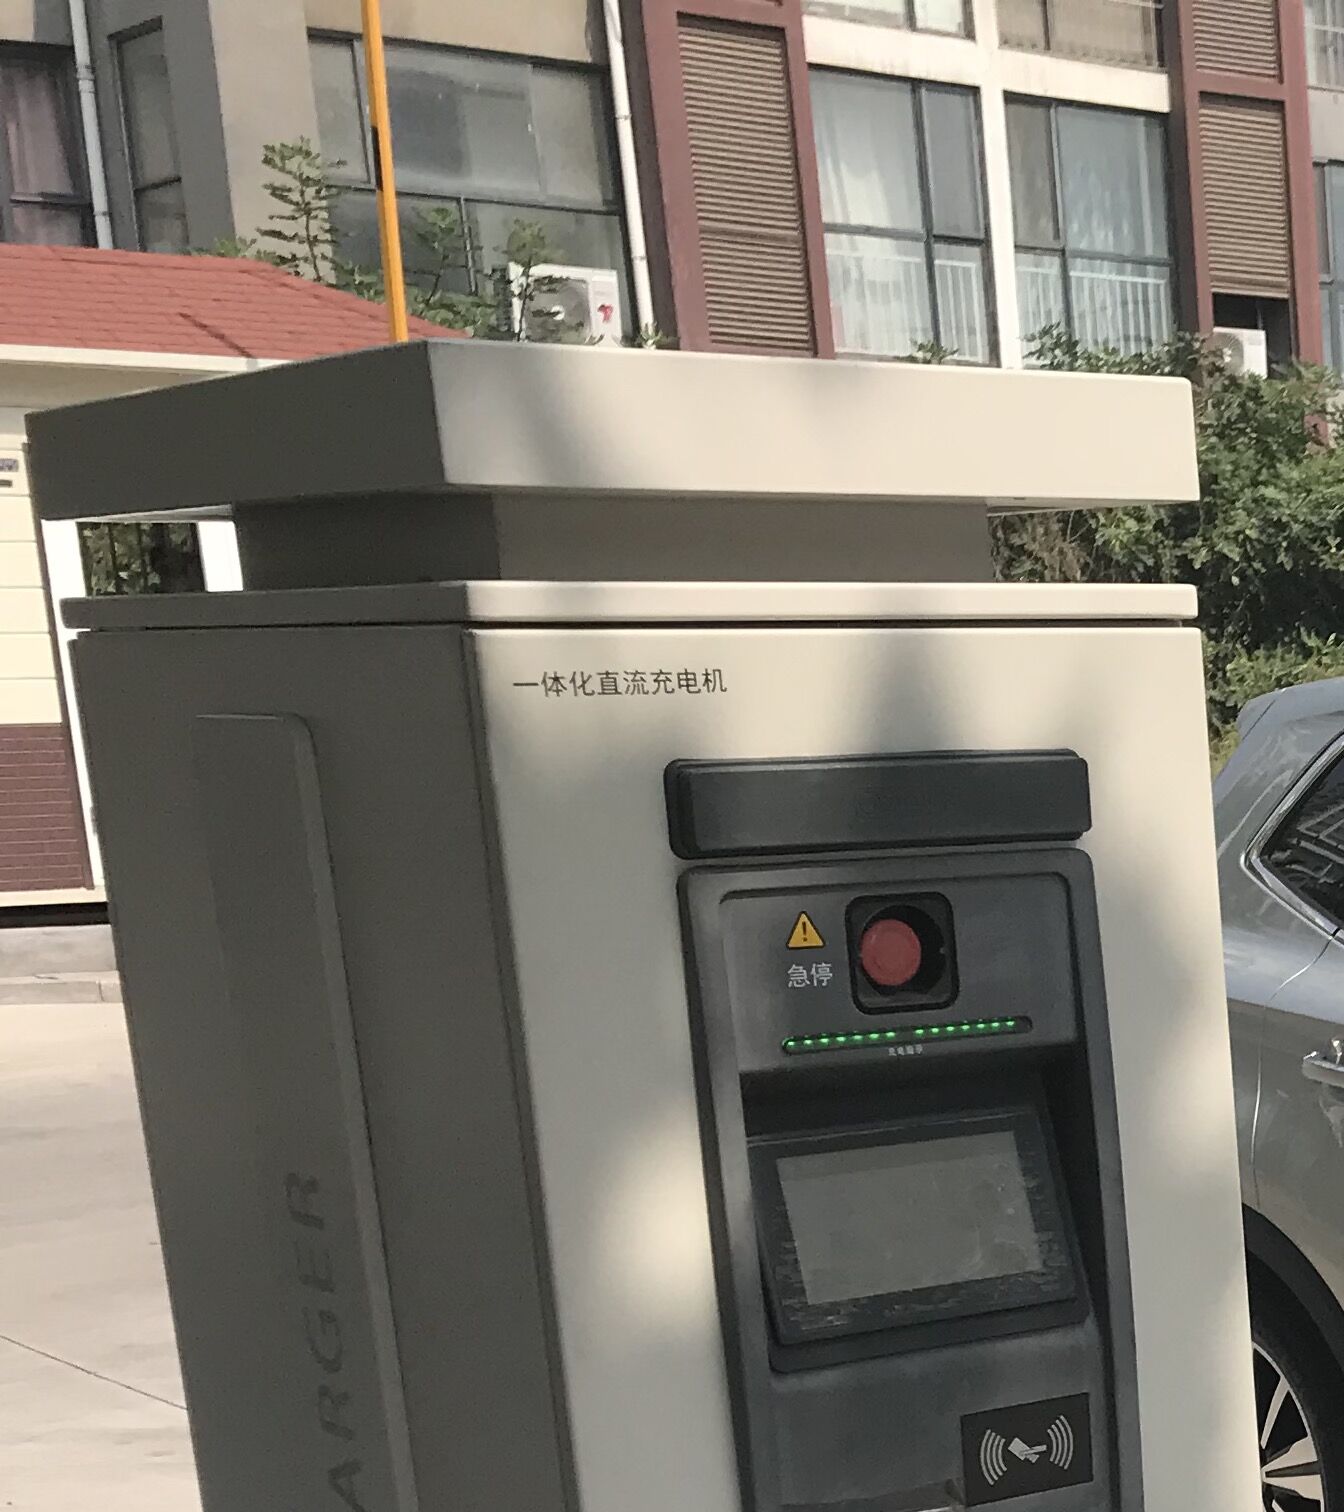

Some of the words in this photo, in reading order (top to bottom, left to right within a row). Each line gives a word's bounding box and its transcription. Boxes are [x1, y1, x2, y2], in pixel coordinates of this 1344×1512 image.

[512, 668, 728, 698] 一体化直流充电机
[787, 962, 833, 988] 急停
